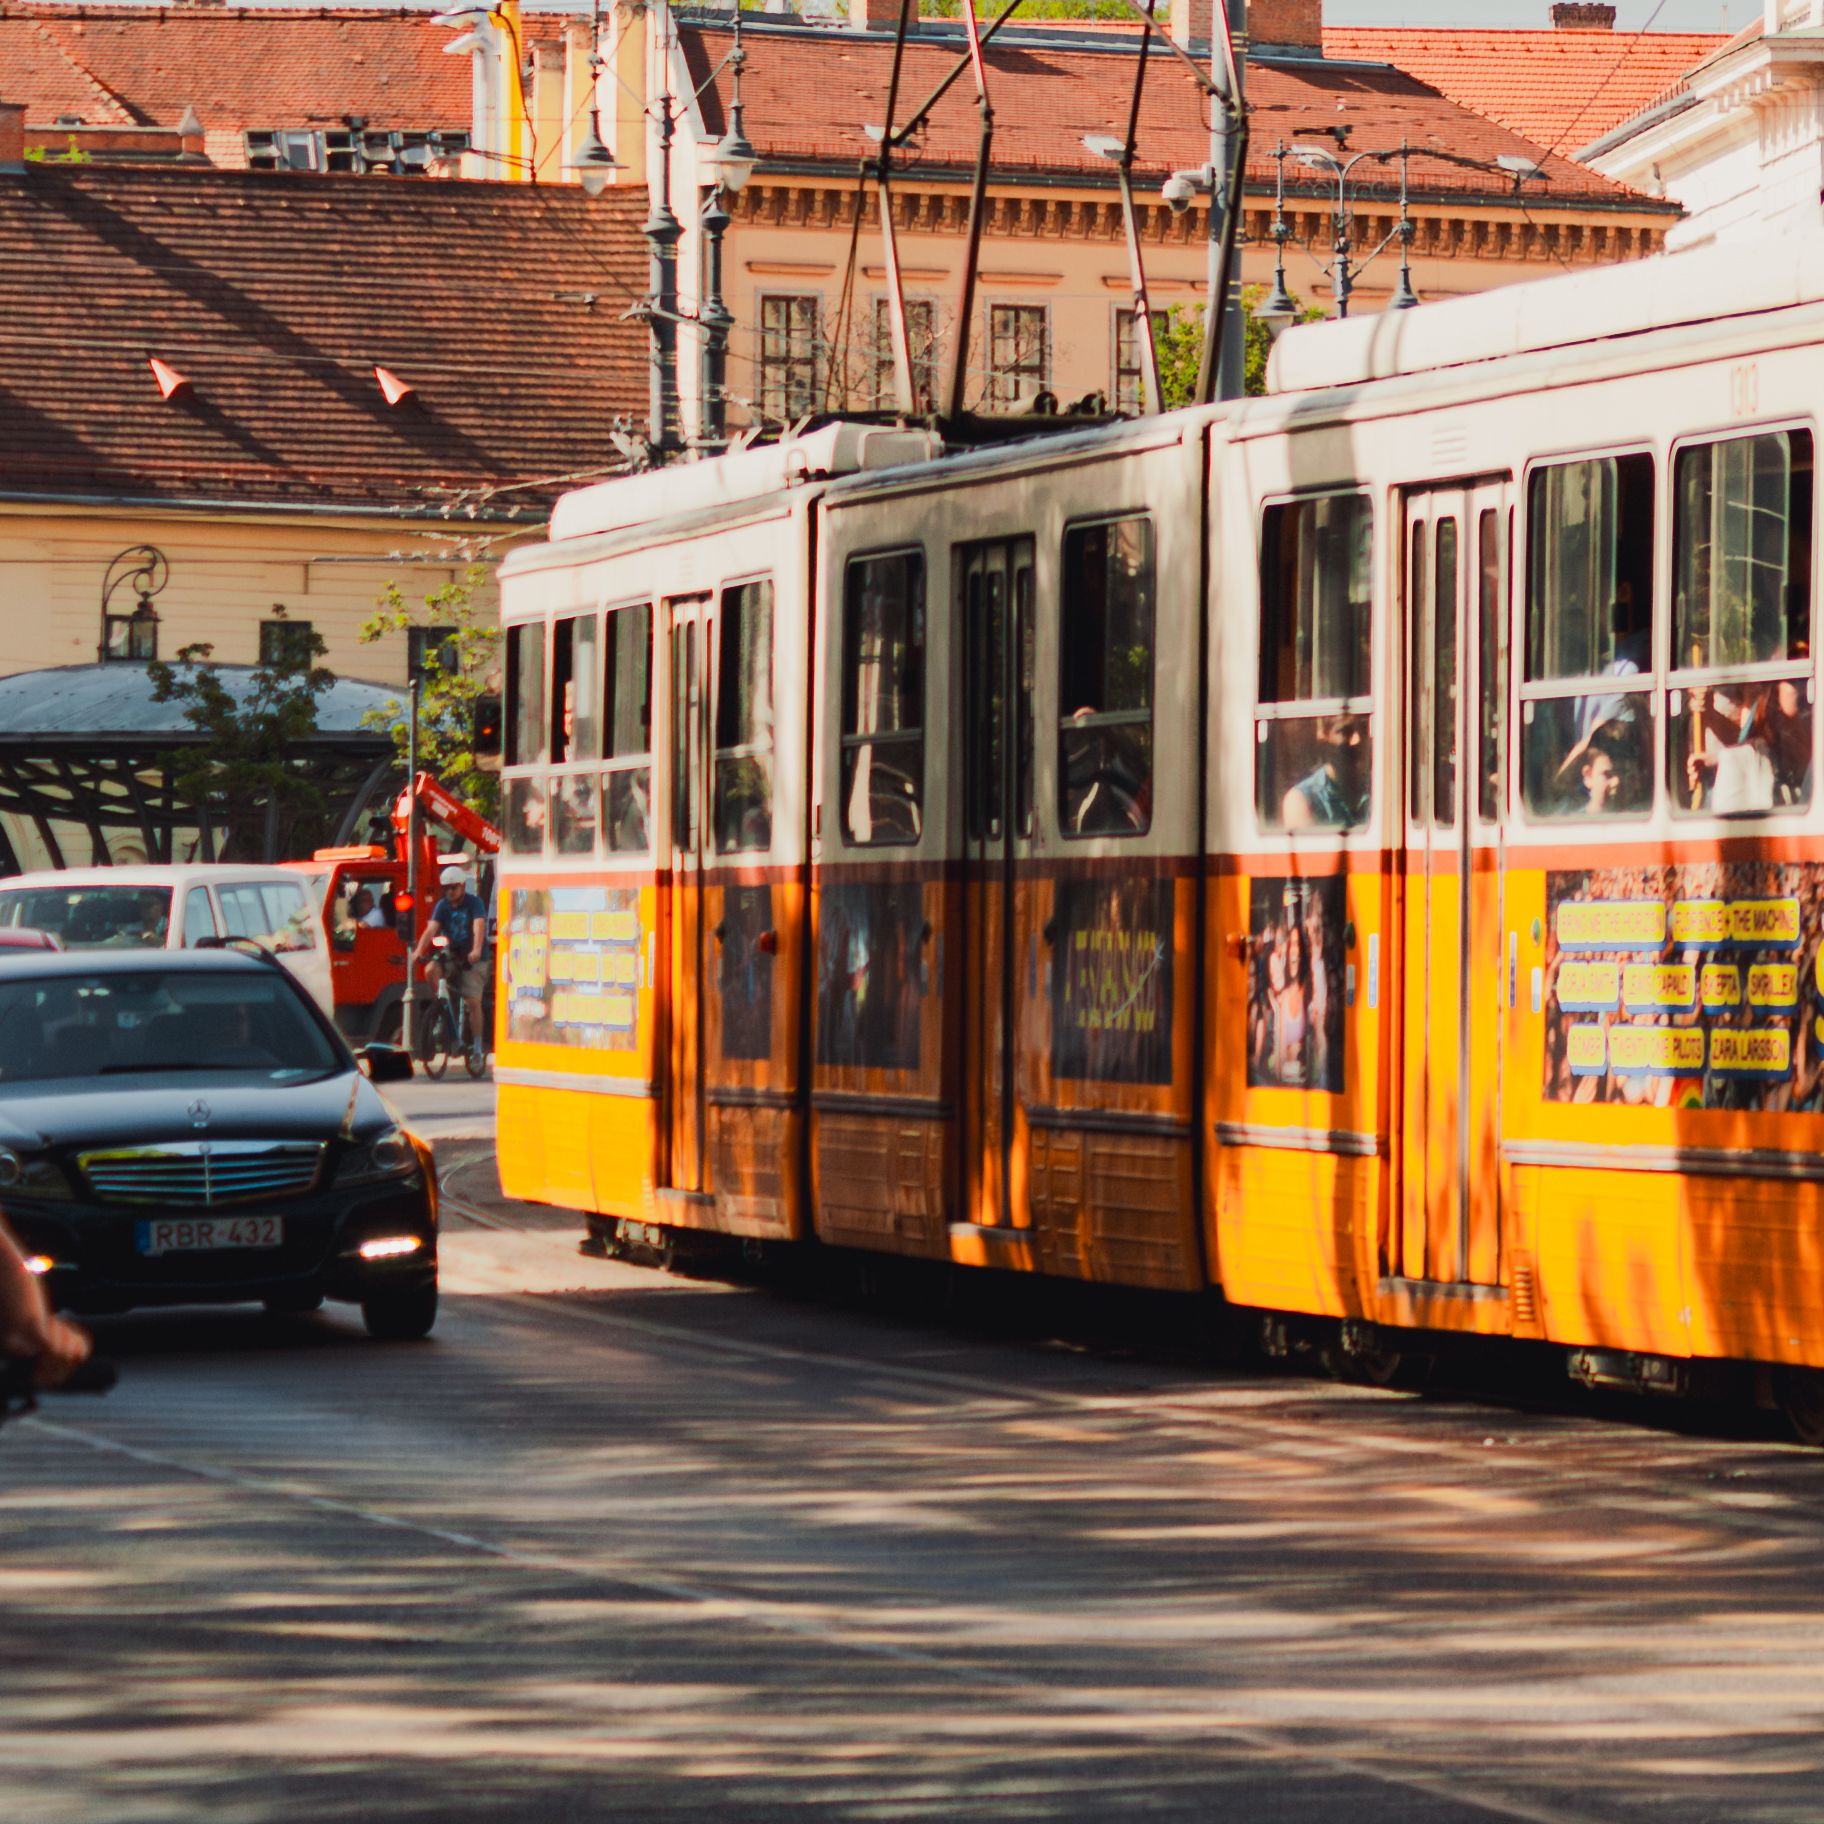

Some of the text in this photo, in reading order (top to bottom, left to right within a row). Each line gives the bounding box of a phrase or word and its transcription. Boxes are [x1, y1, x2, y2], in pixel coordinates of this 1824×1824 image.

[1733, 908, 1752, 931] THE
[1753, 908, 1795, 932] MACHINE
[1672, 1035, 1702, 1060] PILOTS
[1712, 1037, 1787, 1063] ZARA LARSSON
[155, 1218, 276, 1248] RBR-432
